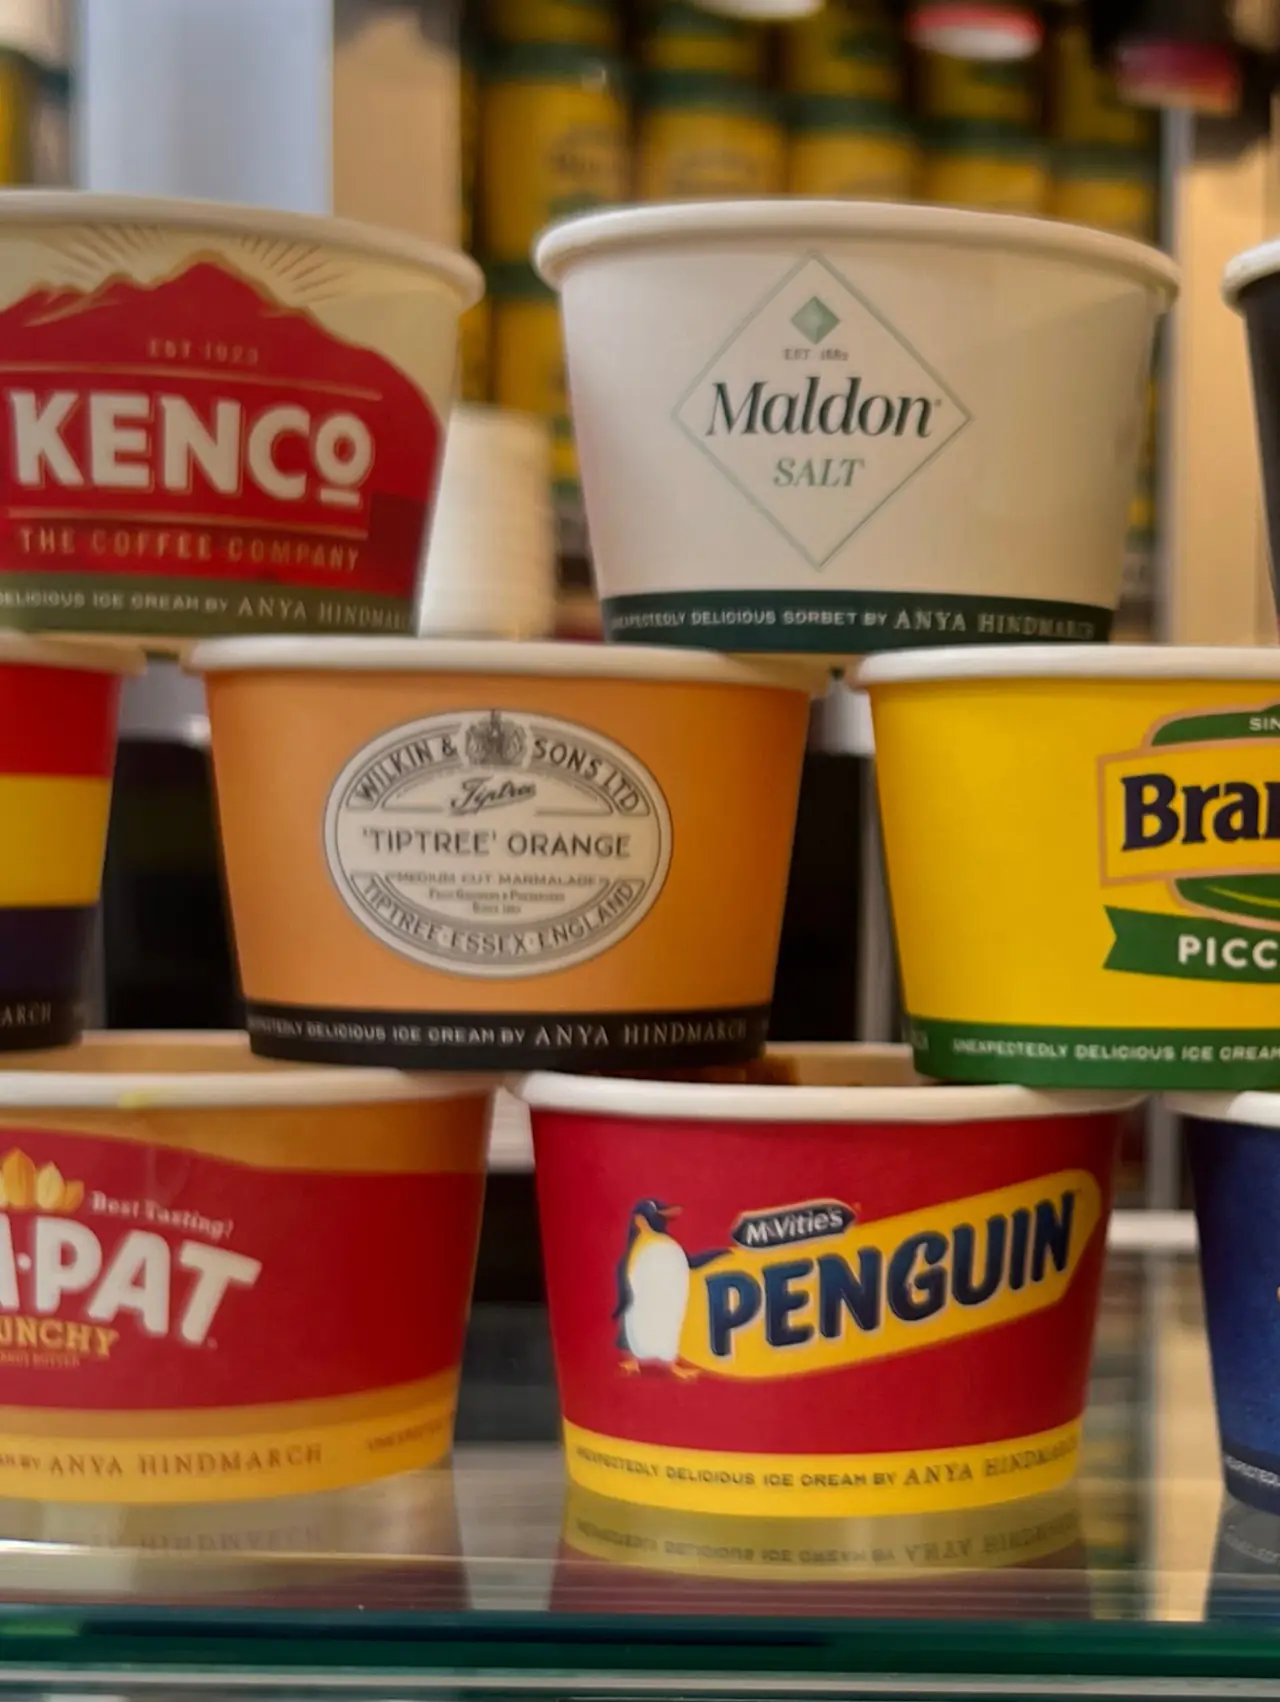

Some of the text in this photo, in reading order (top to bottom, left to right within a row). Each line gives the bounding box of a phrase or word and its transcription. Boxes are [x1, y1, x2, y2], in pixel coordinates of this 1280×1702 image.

[704, 375, 932, 439] Maldon
[772, 457, 865, 488] SALT
[19, 529, 361, 573] THE COFFEE COMPANY
[92, 591, 124, 609] ICE
[130, 592, 200, 612] CREAM
[204, 597, 229, 613] BY
[237, 595, 308, 622] ANYA
[690, 608, 777, 626] DELICIOUS
[782, 609, 858, 627] SORBET
[862, 612, 888, 627] BY
[893, 609, 967, 632] ANYA
[355, 736, 641, 813] WILKIN & SONS LTD
[506, 831, 632, 859] ORANGE
[307, 1020, 387, 1042] DELICIOUS
[392, 1026, 422, 1043] ICE
[427, 1027, 496, 1045] CREAM
[500, 1026, 526, 1044] BY
[534, 1023, 610, 1047] ANYA
[623, 1017, 749, 1046] HINDMARCH
[952, 1036, 1068, 1059] UNEXPECTEDLY
[1074, 1043, 1176, 1061] DELICIOUS
[1180, 1044, 1214, 1062] ICE
[91, 1190, 235, 1240] Best Tasting!
[704, 1189, 1077, 1358] PENGUIN
[49, 1453, 125, 1478] ANYA
[138, 1443, 324, 1477] HINDMARCH
[665, 1465, 757, 1486] DELICIOUS
[763, 1473, 795, 1488] ICE
[800, 1473, 867, 1487] CREAM
[872, 1471, 899, 1486] BY
[902, 1462, 974, 1486] ANYA
